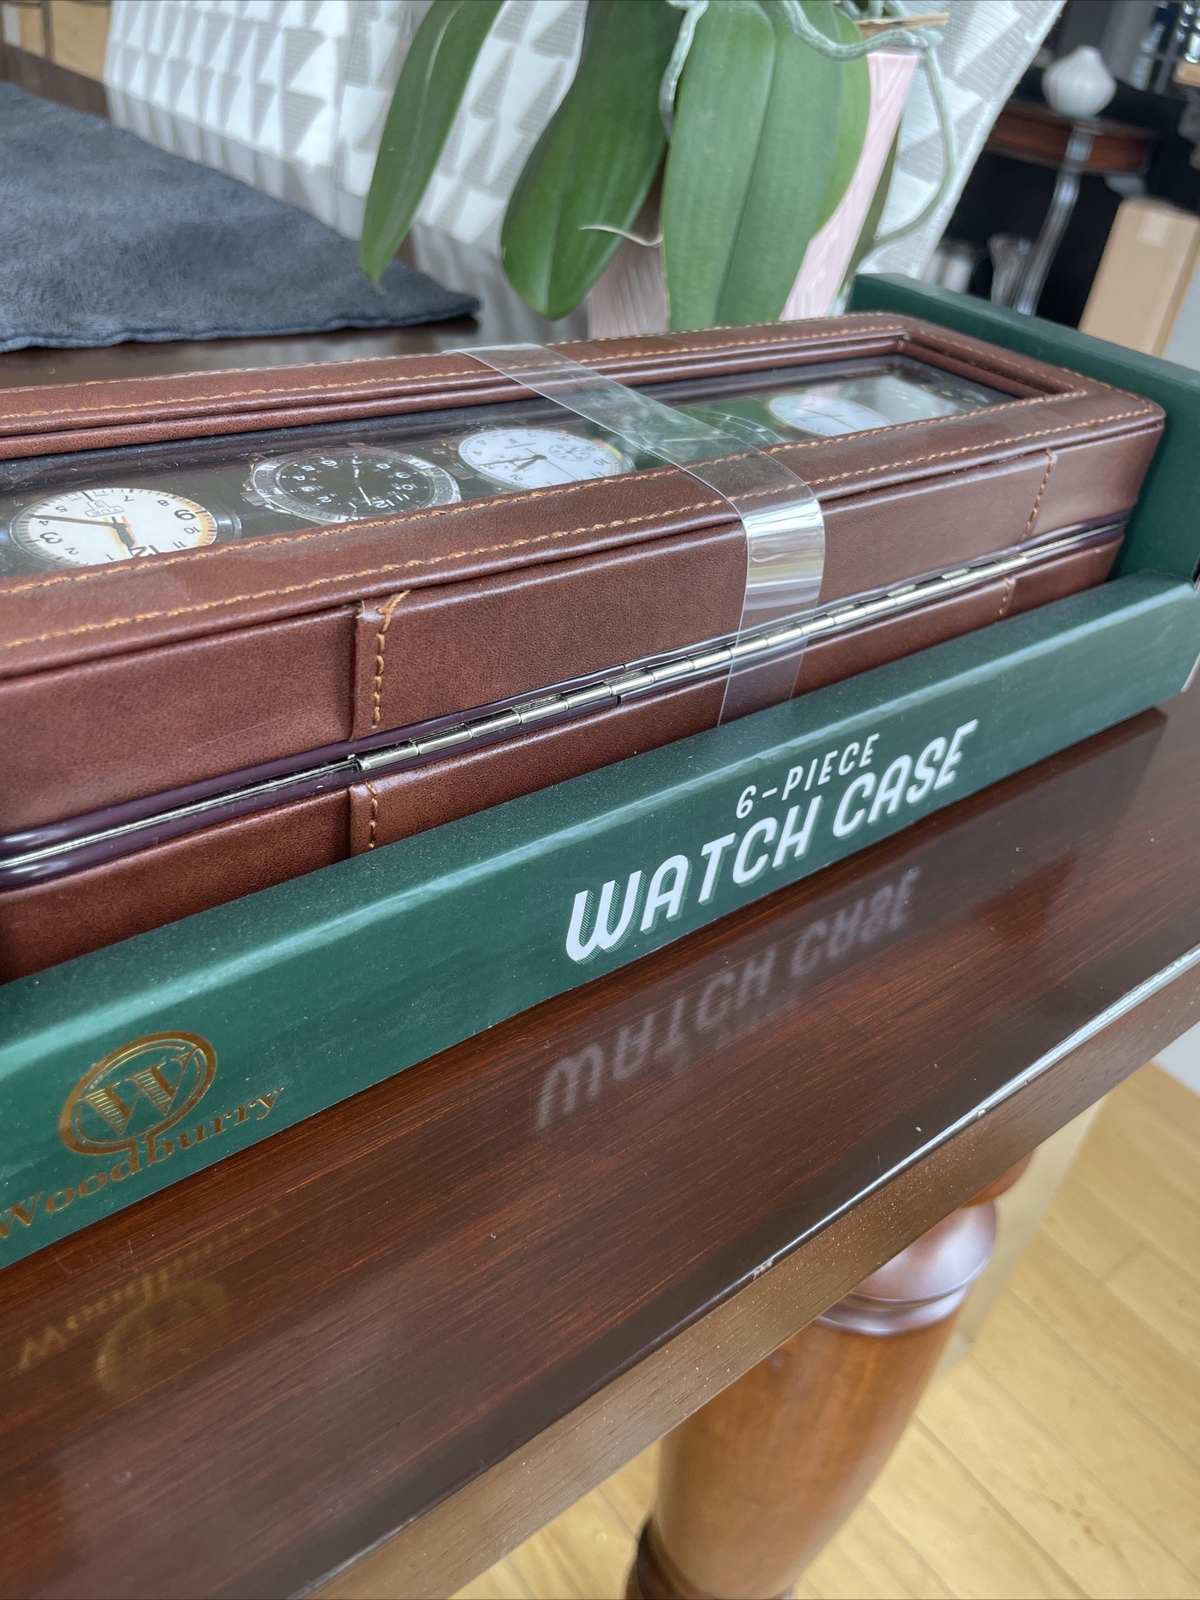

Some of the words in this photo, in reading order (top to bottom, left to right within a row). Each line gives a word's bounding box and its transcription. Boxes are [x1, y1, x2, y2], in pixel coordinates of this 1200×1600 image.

[372, 499, 396, 509] 12
[173, 508, 197, 521] 9
[183, 526, 201, 535] 10
[39, 531, 63, 545] 3
[735, 732, 880, 820] 6-PIECE
[565, 795, 824, 963] WATCH
[832, 718, 980, 839] CASE
[0, 1086, 285, 1239] Woodburry
